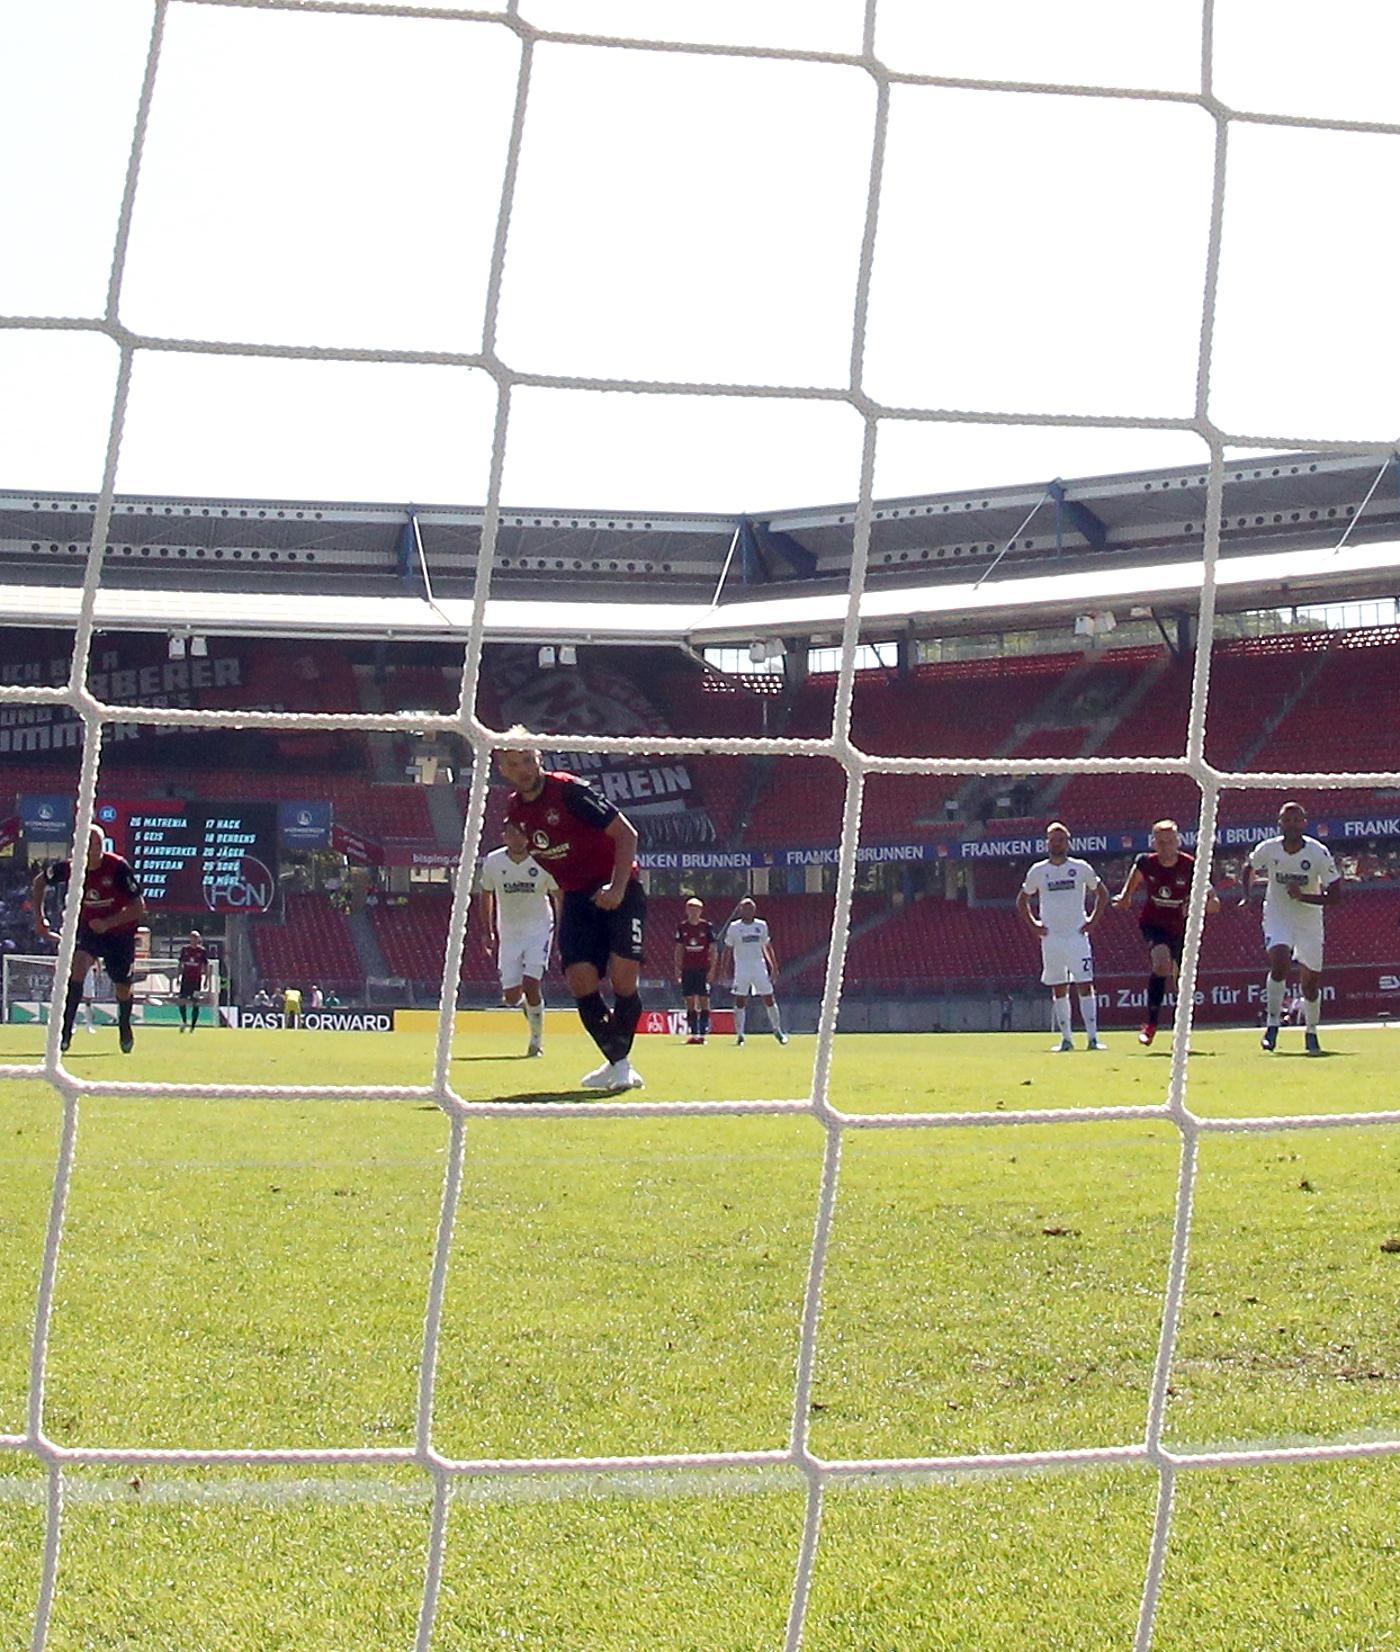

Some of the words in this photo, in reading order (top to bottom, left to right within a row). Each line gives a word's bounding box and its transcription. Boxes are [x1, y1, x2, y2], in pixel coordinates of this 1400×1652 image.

[1226, 827, 1281, 845] BRUNN
[961, 840, 1032, 857] FRANKEN
[1035, 835, 1107, 853] BRNNEN
[413, 853, 462, 866] bisping.d
[634, 853, 678, 868] NKEN
[681, 853, 752, 868] BRUNNEN
[786, 849, 841, 865] FRANKE
[856, 846, 924, 862] BRUNNEN
[631, 918, 643, 943] 5
[1211, 985, 1241, 1004] für
[242, 1013, 286, 1030] PAST
[294, 1014, 391, 1031] FORWARD
